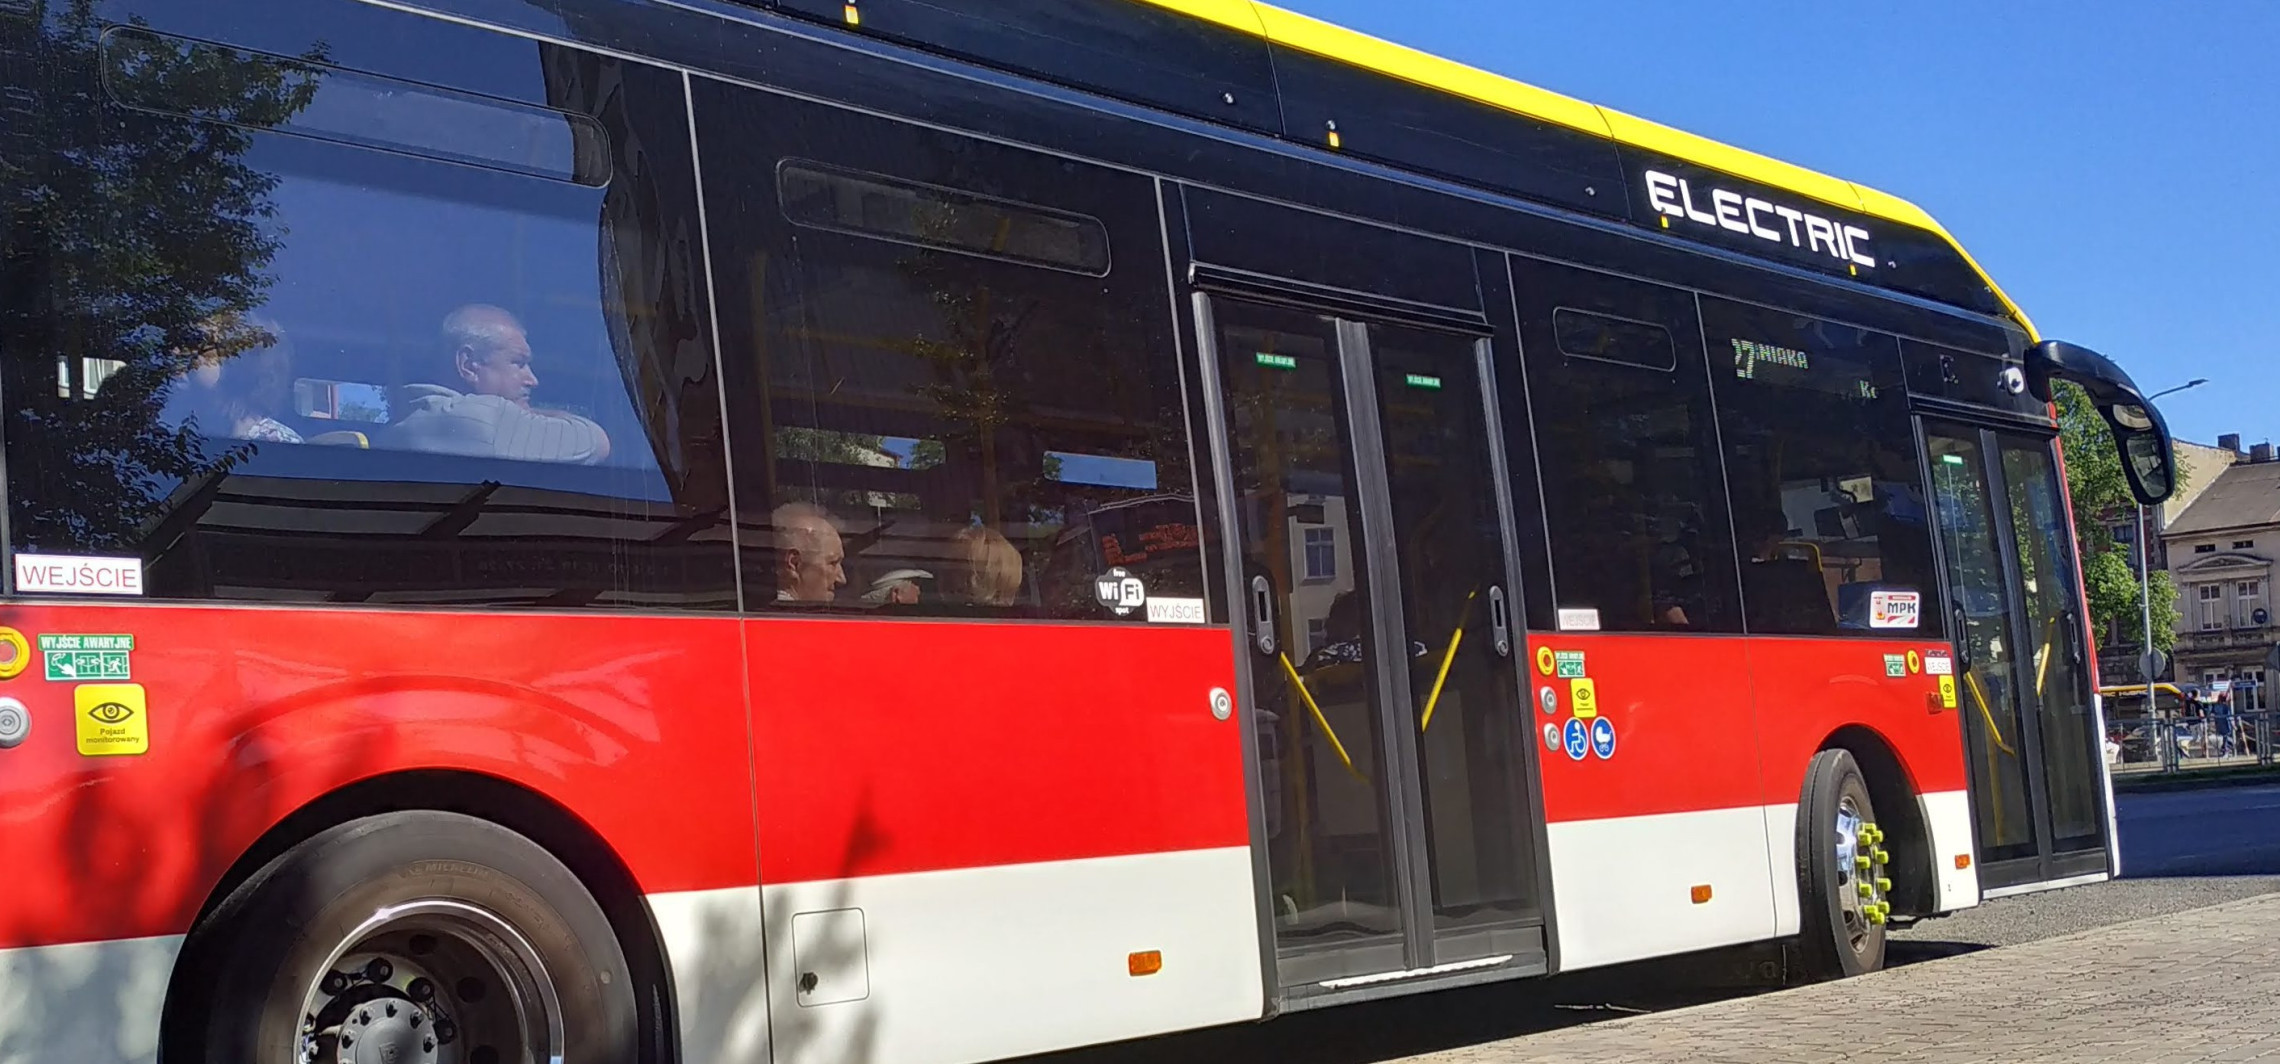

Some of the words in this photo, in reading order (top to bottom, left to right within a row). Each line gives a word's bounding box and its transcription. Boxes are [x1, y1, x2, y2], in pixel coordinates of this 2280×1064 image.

[1645, 170, 1875, 268] ELECTRIC
[22, 563, 138, 588] WEJŚCIE
[1113, 569, 1126, 577] free
[1115, 607, 1129, 615] spot
[1149, 603, 1202, 619] WYJŚCIE
[1887, 602, 1916, 614] MPK
[40, 634, 82, 649] WYJŚCIE
[84, 636, 132, 649] AWARYJNE
[100, 728, 126, 736] Pojazd
